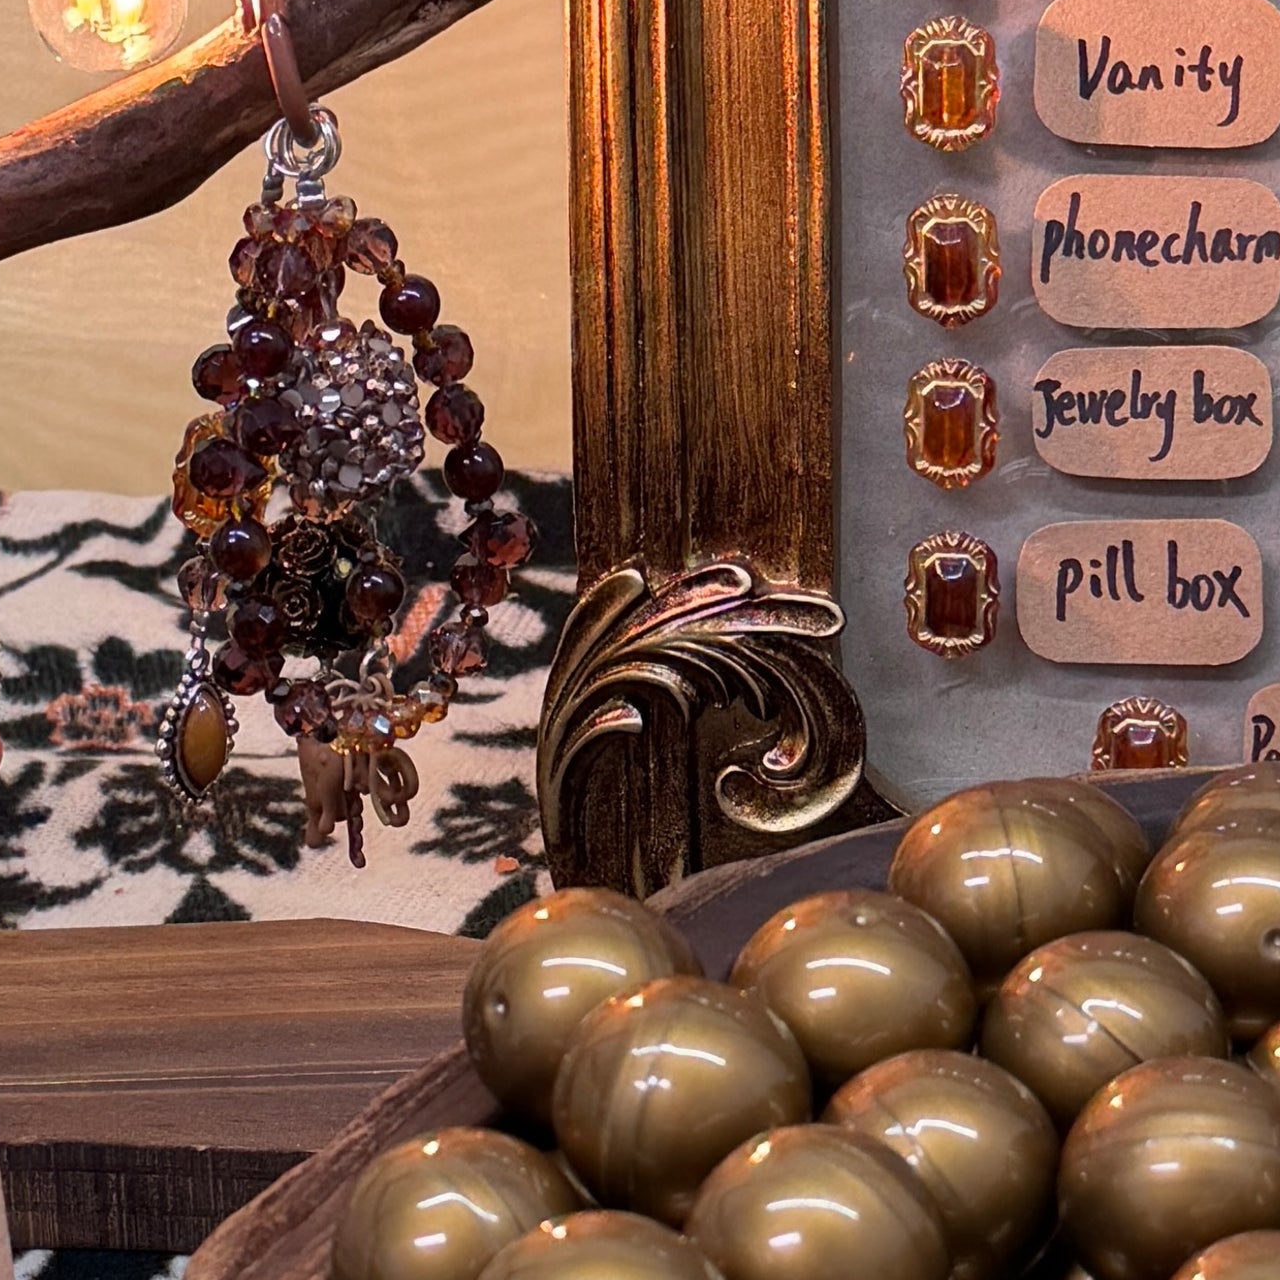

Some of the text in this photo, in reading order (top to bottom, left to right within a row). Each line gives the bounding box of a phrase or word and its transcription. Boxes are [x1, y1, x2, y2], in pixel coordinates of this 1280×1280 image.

[1078, 36, 1243, 126] Vanity
[1193, 369, 1264, 426] box
[1056, 538, 1250, 621] pill box
